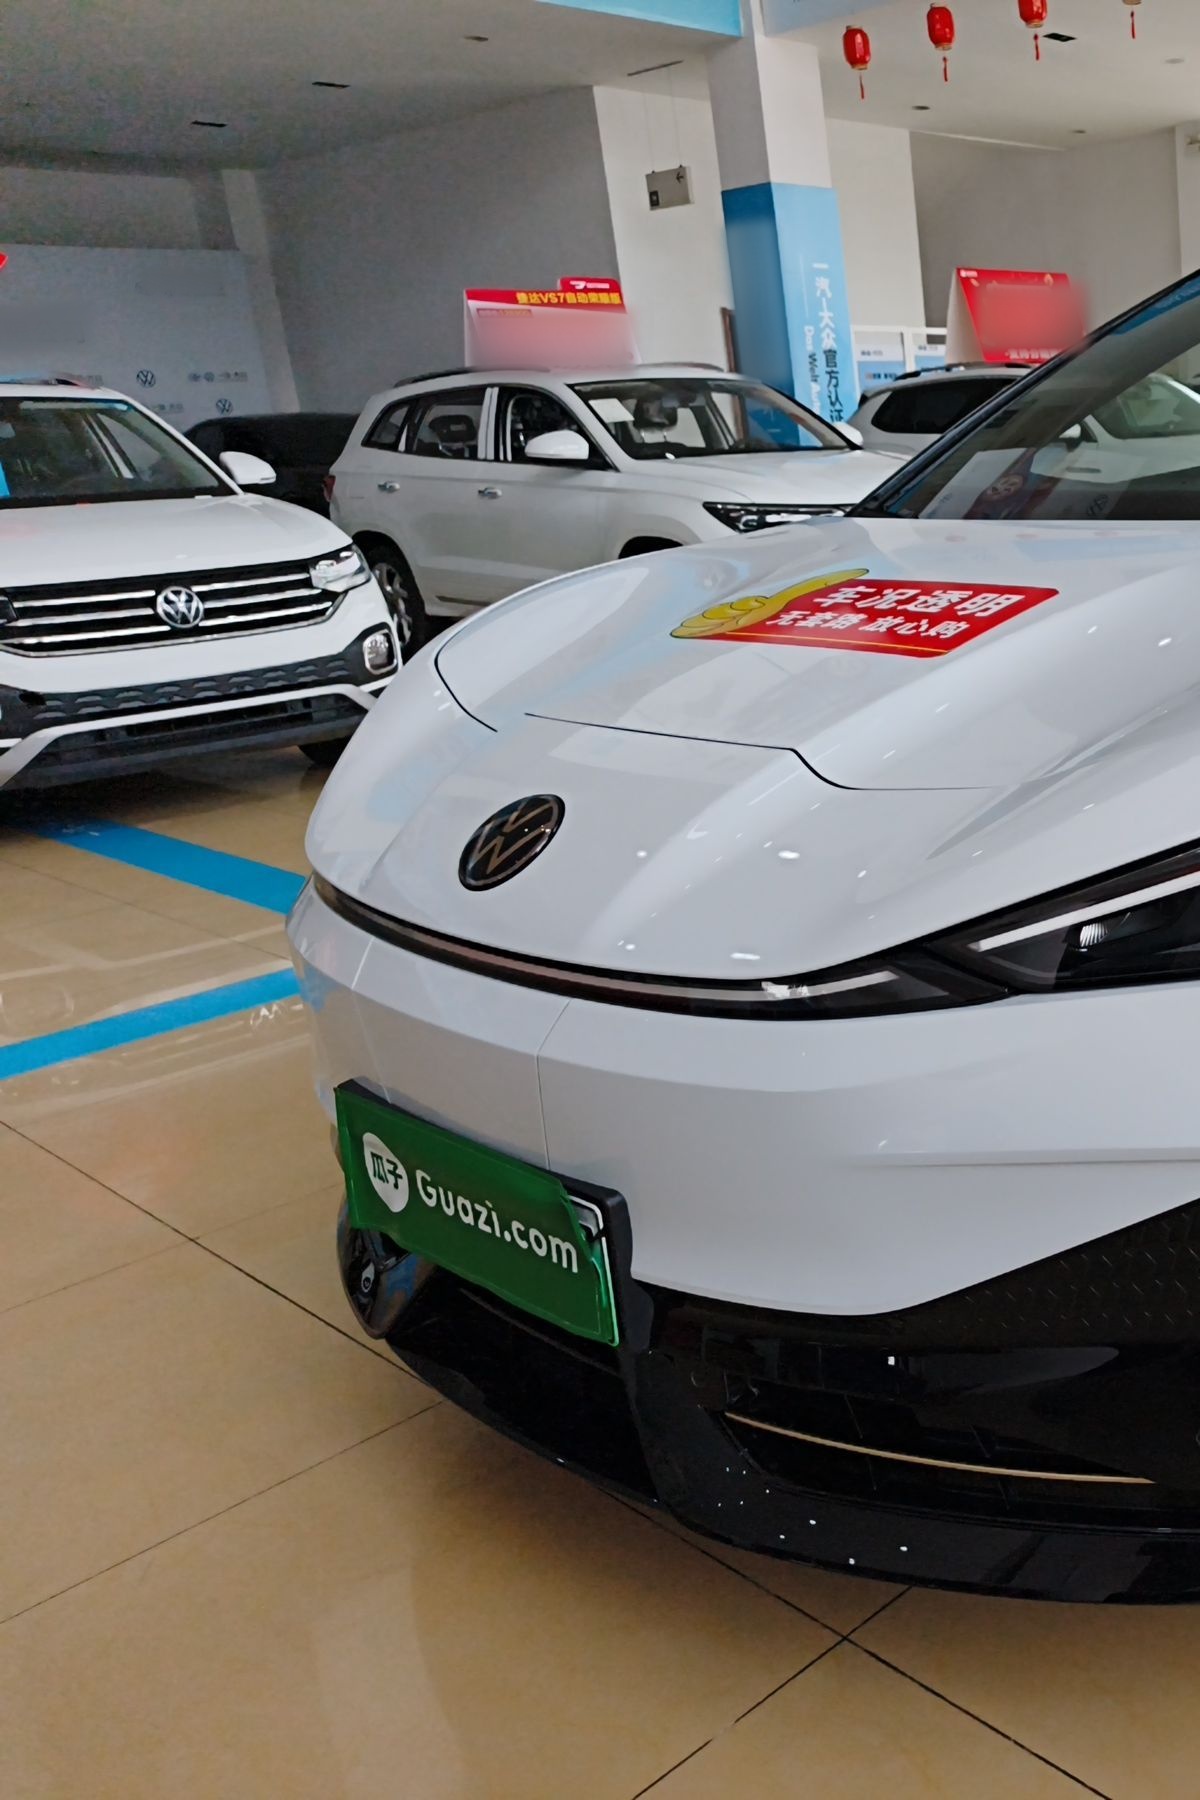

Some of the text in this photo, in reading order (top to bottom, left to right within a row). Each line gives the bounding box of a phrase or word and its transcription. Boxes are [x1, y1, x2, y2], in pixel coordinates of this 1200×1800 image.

[814, 586, 1025, 617] 车况透明
[766, 610, 969, 640] 无套路 放心购
[370, 1151, 403, 1190] 瓜子
[415, 1168, 579, 1274] Guazi.com
